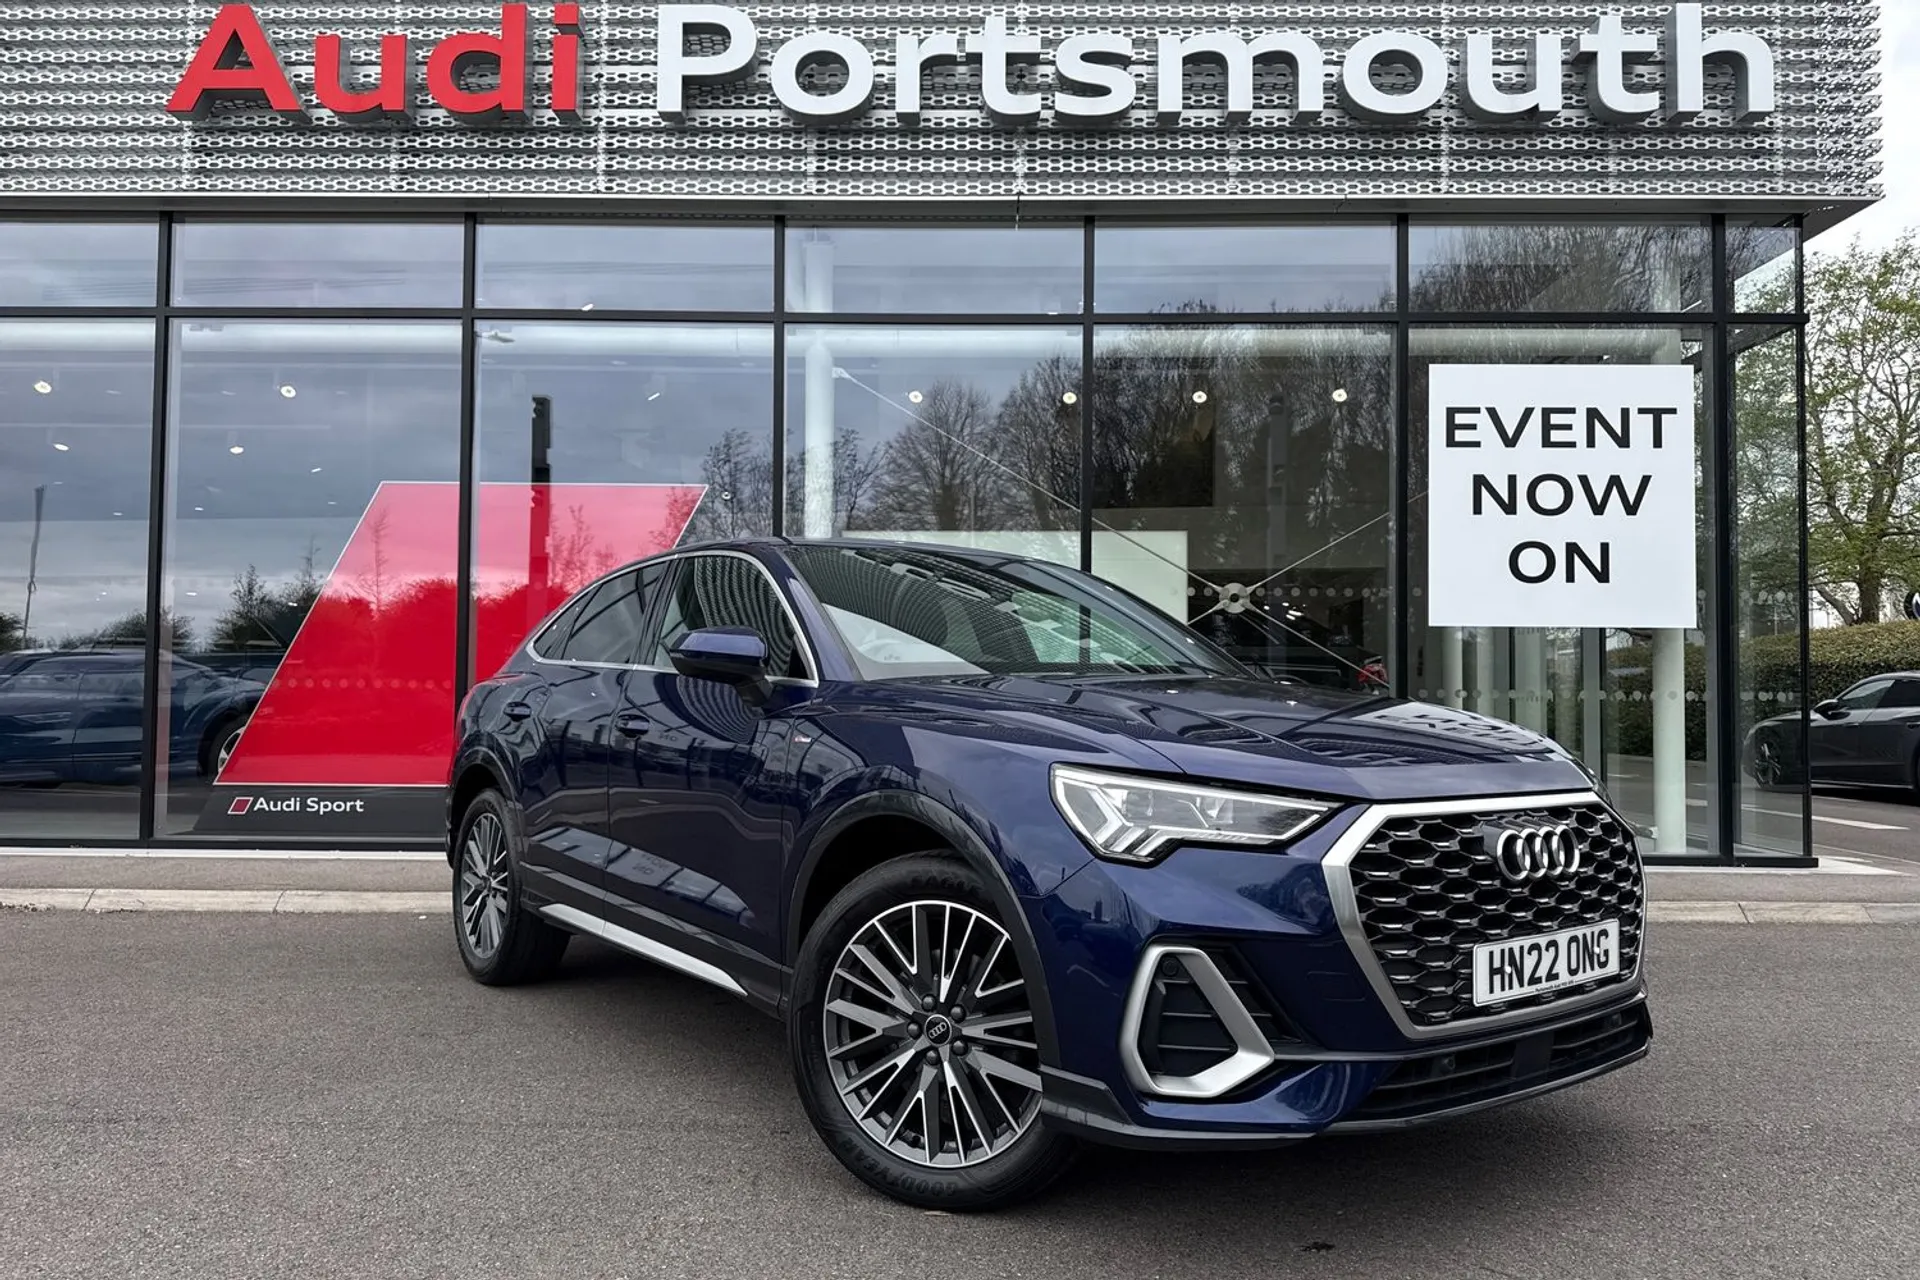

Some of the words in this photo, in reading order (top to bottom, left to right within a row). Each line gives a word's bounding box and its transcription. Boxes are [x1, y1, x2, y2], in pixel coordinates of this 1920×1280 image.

[166, 3, 582, 116] Audi
[655, 2, 1776, 118] Portsmouth
[1445, 406, 1678, 449] EVENT
[1472, 473, 1653, 517] NOW
[1508, 540, 1611, 584] ON
[253, 796, 301, 812] Audi
[305, 796, 365, 816] Sport
[1487, 938, 1560, 995] HN22
[1566, 928, 1610, 977] ONG
